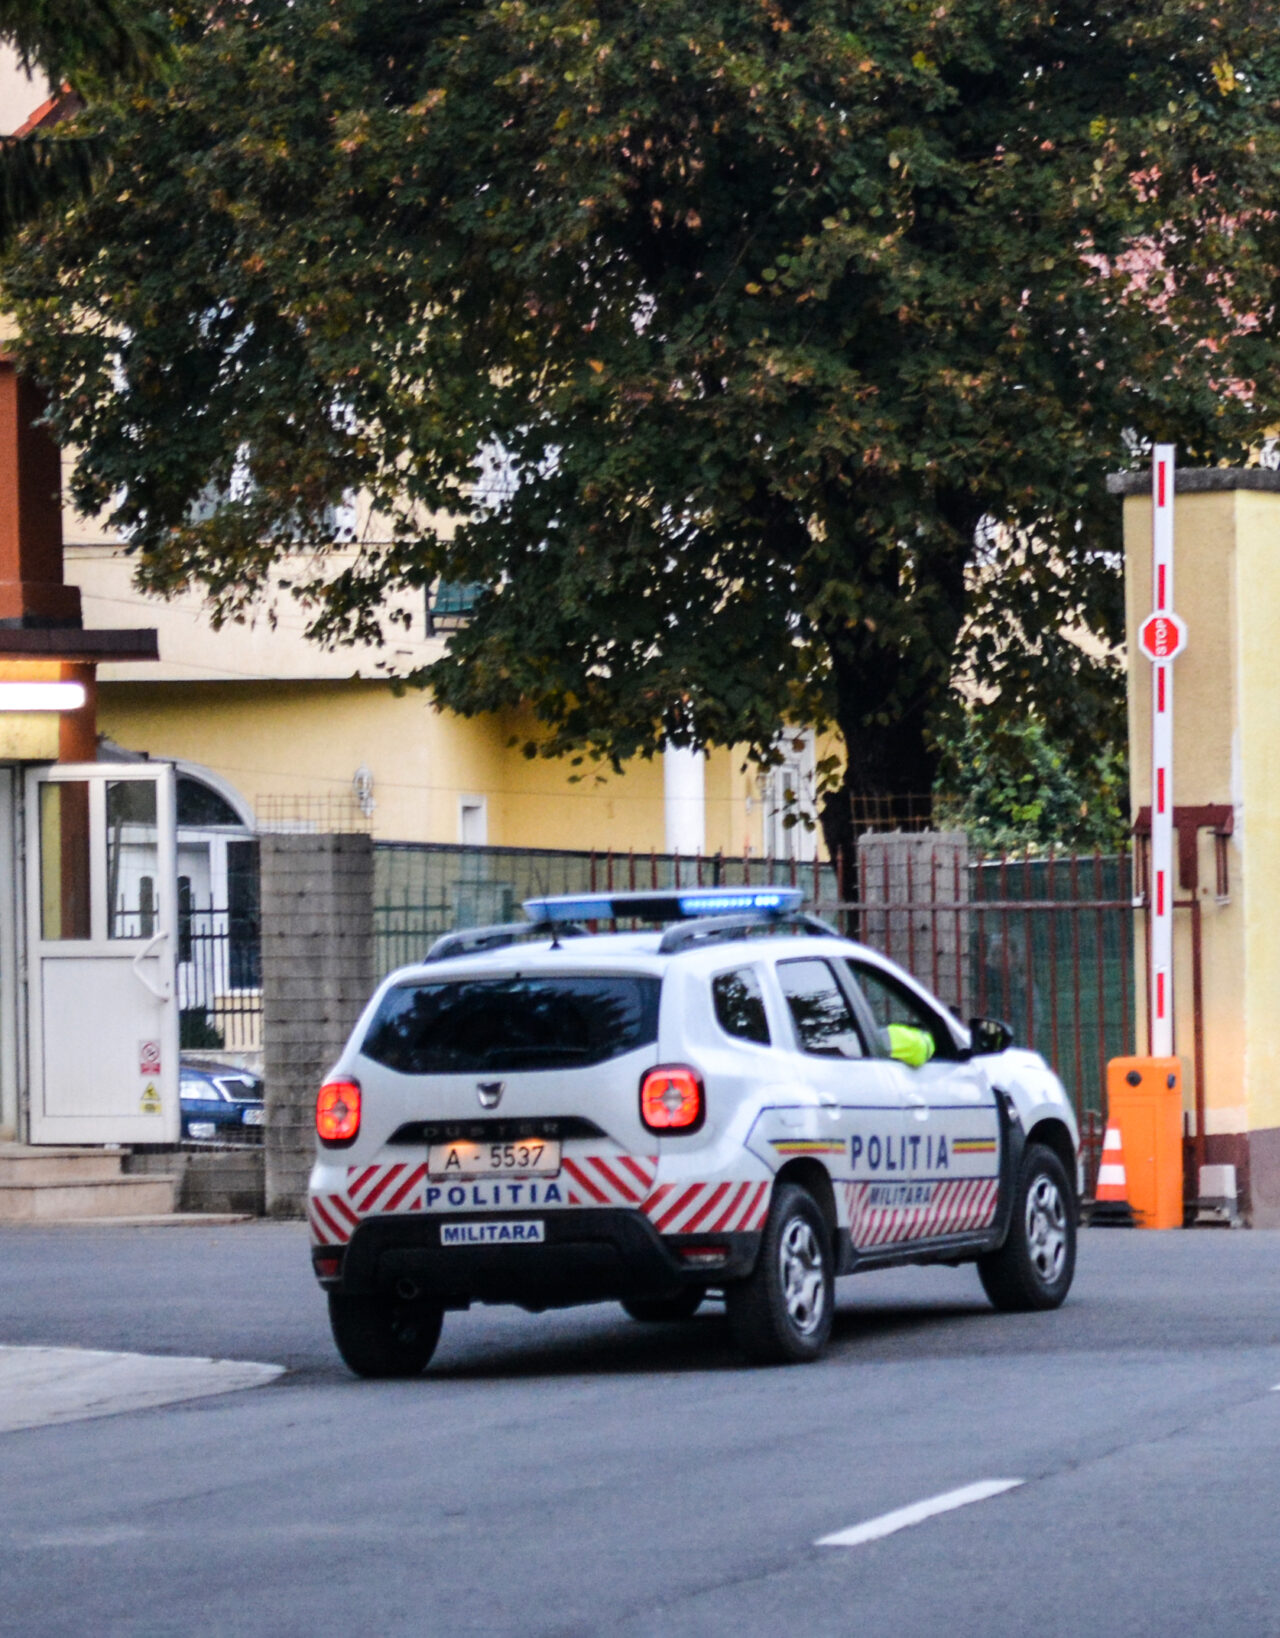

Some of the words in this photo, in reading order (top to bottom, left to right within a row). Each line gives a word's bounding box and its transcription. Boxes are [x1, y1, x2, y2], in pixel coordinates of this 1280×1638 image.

[1155, 620, 1167, 655] STOP
[422, 1122, 560, 1138] DUSTER
[445, 1148, 461, 1170] A
[490, 1145, 545, 1168] 5537
[851, 1135, 948, 1170] POLITIA
[426, 1184, 562, 1207] POLITIA
[871, 1187, 930, 1205] MILITARA
[444, 1223, 540, 1242] MILITARA
